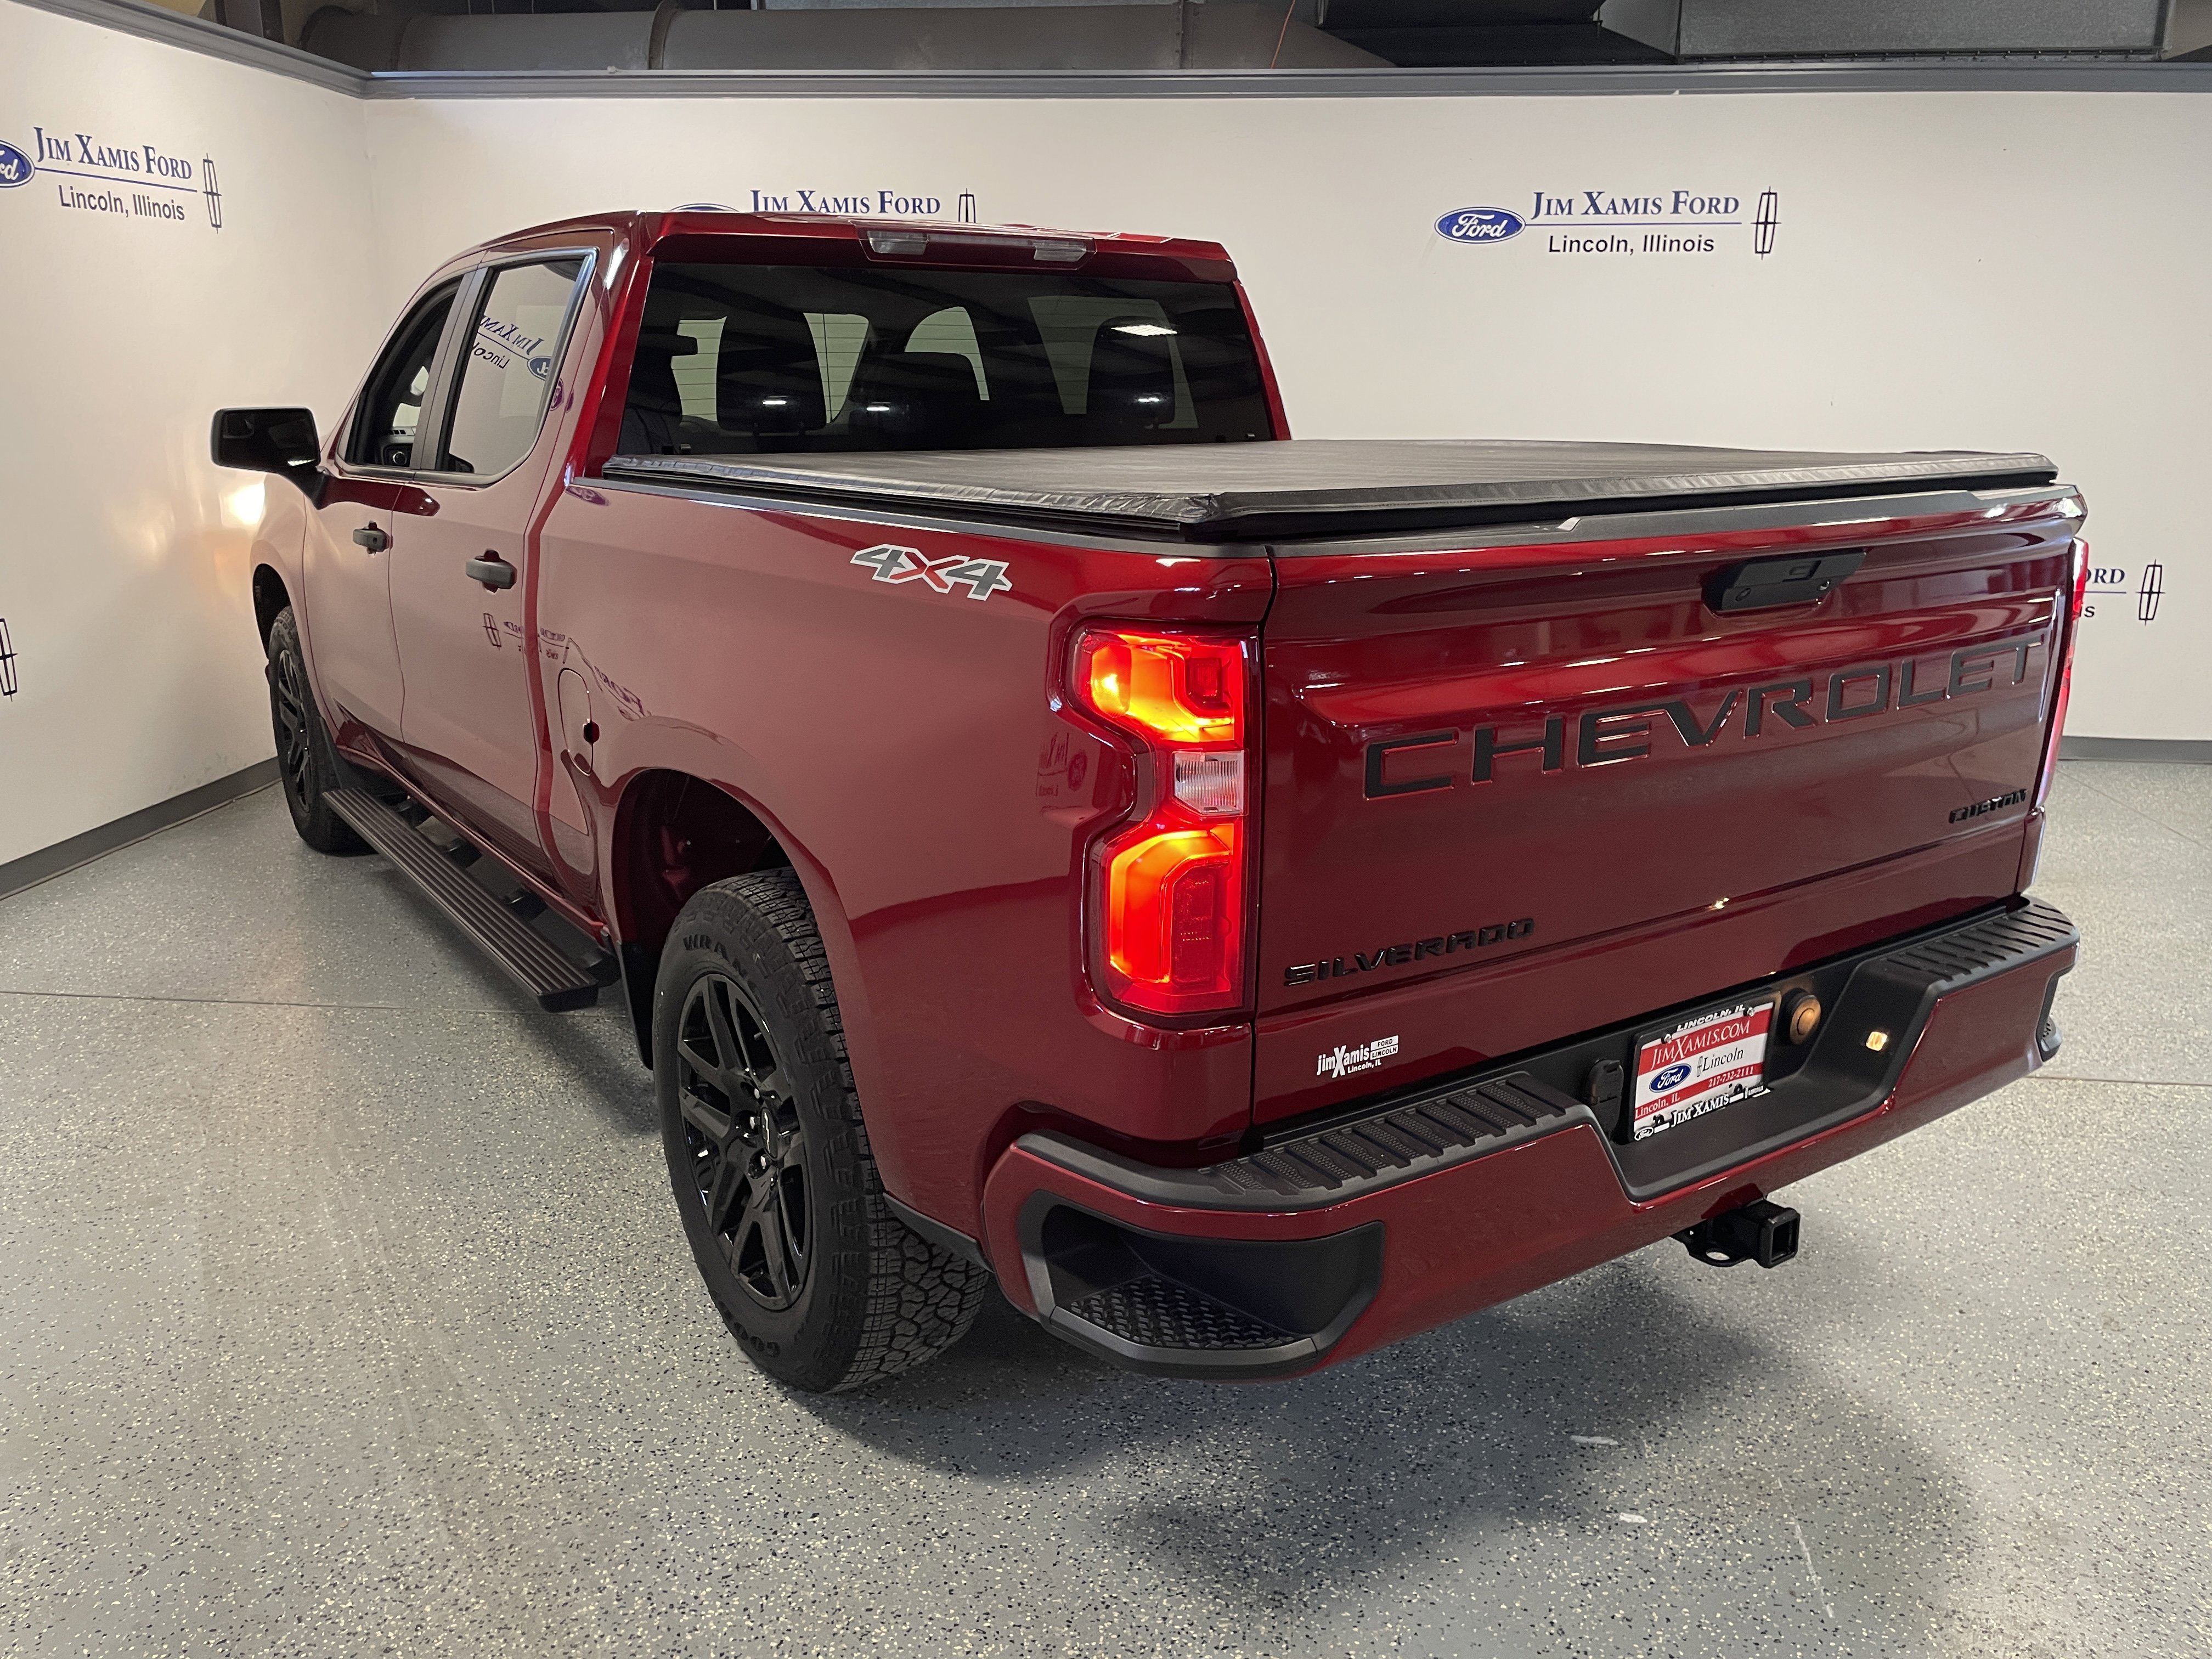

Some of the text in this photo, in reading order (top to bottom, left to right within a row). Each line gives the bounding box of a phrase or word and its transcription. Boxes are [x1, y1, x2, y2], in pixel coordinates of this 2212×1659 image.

[75, 133, 140, 172] XAMIS
[143, 145, 192, 179] FORD
[59, 185, 185, 221] Lincoln, Illinois
[795, 190, 870, 213] XAMIS
[878, 190, 941, 215] FORD
[1531, 190, 1740, 219] JIM XAMIS FORD
[1452, 213, 1506, 239] Ford
[1548, 234, 1715, 256] Lincoln, Illinois
[1364, 640, 2043, 800] CHEVROLET
[1949, 788, 2028, 824] CUSTOM
[1283, 917, 1536, 986] SILVERADO
[1676, 1004, 1745, 1032] LINCOLN, IL
[1377, 1039, 1393, 1048] FORD
[1651, 1020, 1750, 1070] JIMXAMIS.COM
[1347, 1062, 1374, 1074] Lincoln,
[1702, 1047, 1744, 1072] Lincoln
[1657, 1067, 1684, 1089] Ford
[1708, 1066, 1754, 1088] 217-732-2111
[1671, 1094, 1730, 1127] JIM XAMIS
[1672, 1093, 1680, 1104] IL
